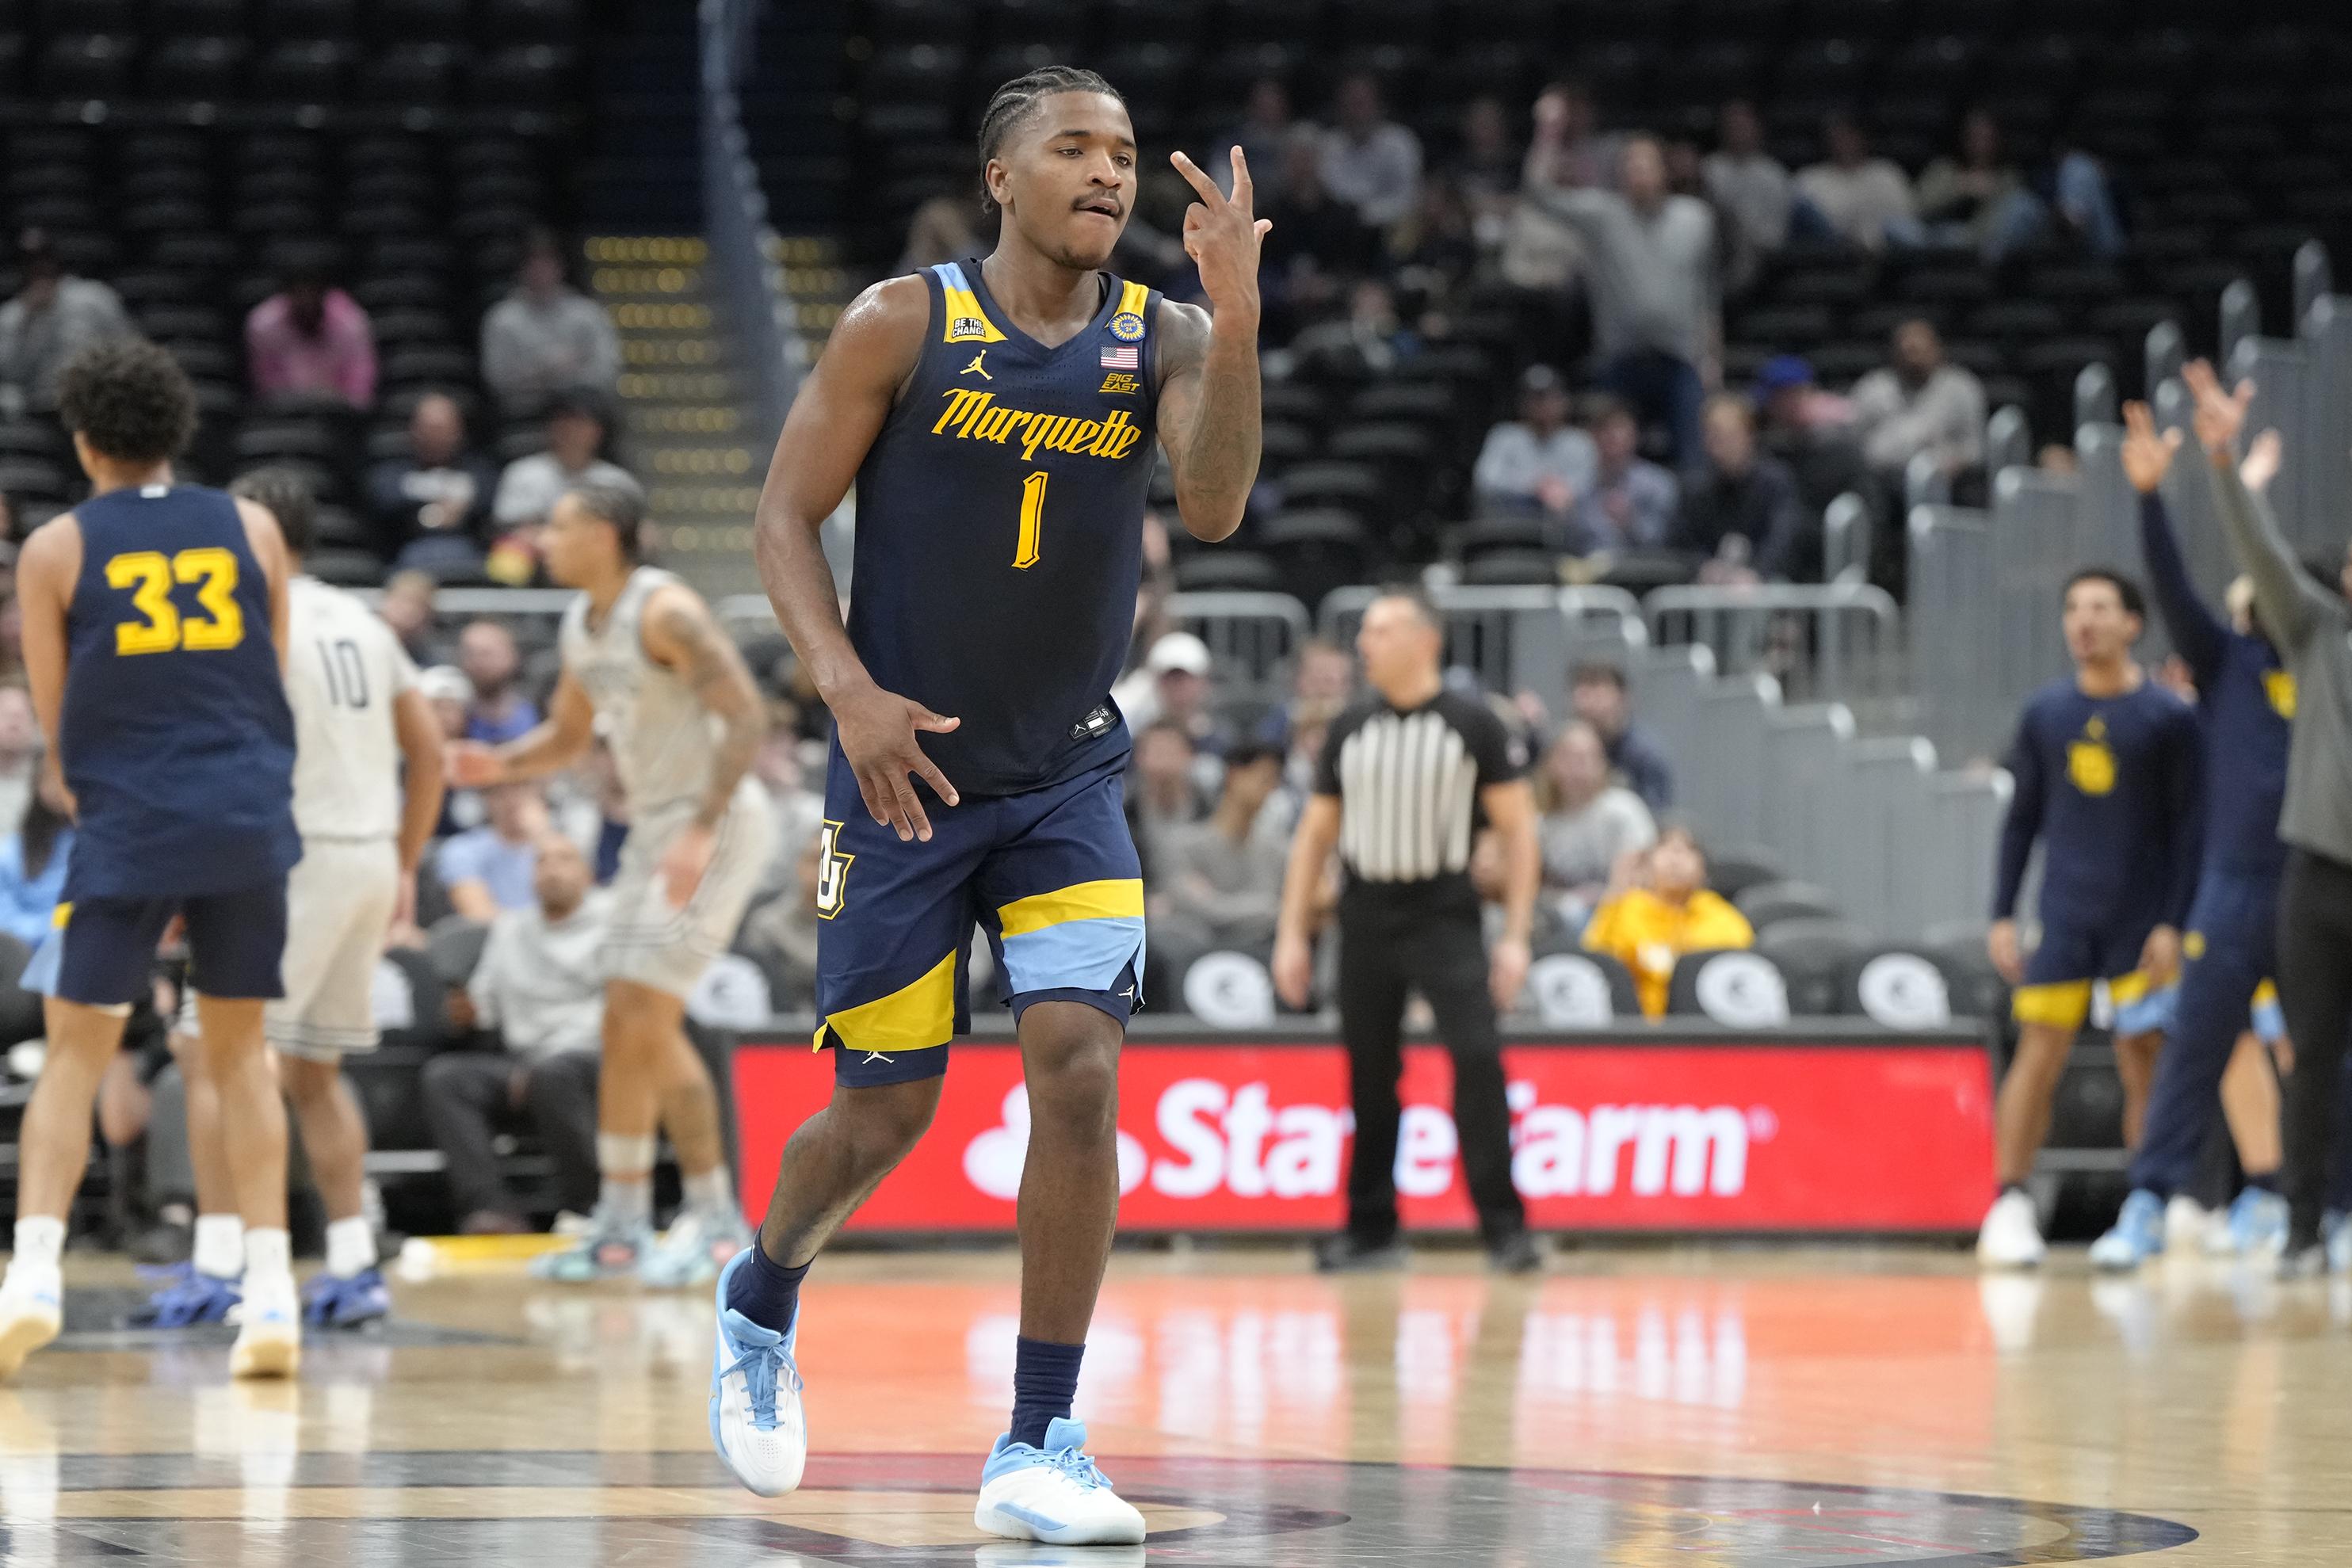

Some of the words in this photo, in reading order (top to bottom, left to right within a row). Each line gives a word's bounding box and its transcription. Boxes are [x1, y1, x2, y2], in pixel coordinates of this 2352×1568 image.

[952, 326, 986, 338] CHANGE
[954, 319, 967, 328] BE
[968, 319, 983, 329] THE
[1101, 381, 1140, 391] EAST
[1105, 372, 1134, 382] BIG
[931, 387, 1142, 461] Marquette
[1011, 471, 1049, 569] 1
[104, 547, 245, 656] 33
[317, 638, 369, 709] 10
[1151, 1078, 1460, 1199] Stae
[1503, 1079, 1748, 1199] arm
